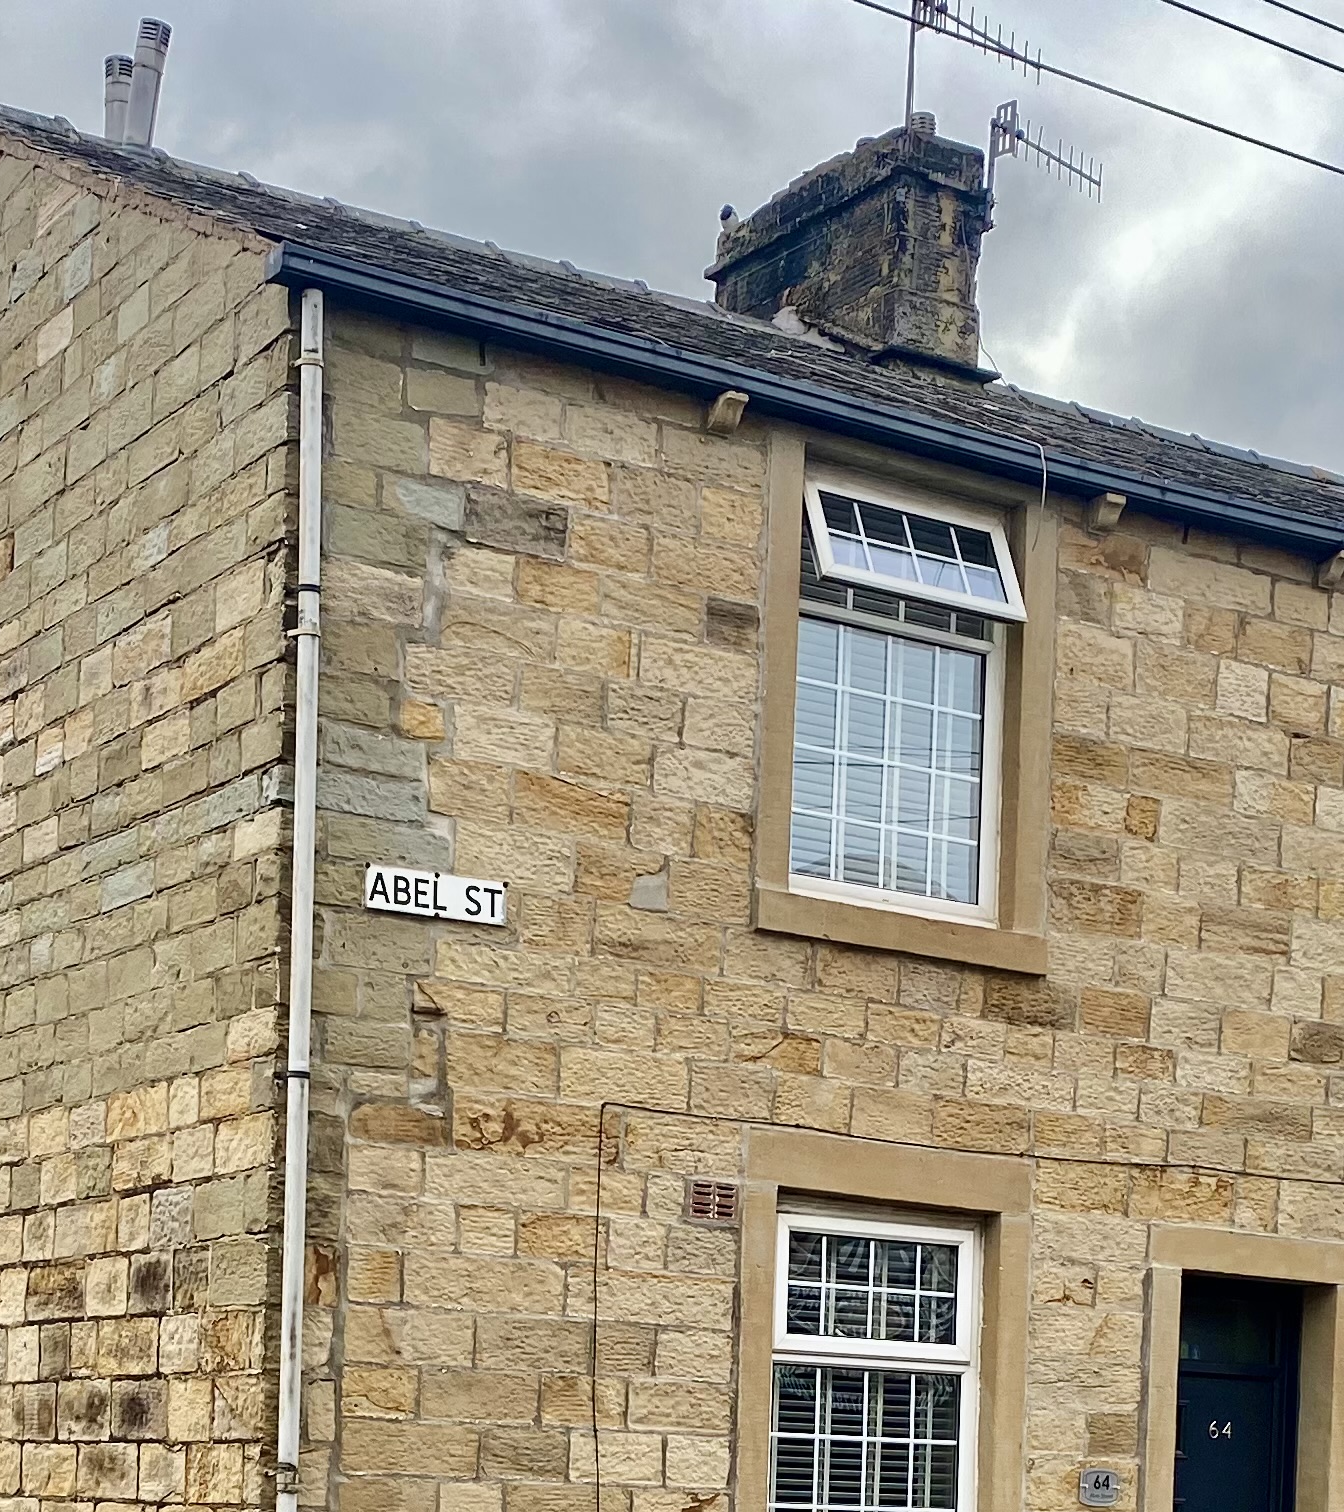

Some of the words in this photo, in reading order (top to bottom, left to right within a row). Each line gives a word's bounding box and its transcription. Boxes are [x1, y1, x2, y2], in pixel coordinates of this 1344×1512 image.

[369, 872, 447, 912] ABEL
[465, 885, 503, 918] ST
[1209, 1420, 1232, 1440] 64
[1093, 1474, 1110, 1490] 64
